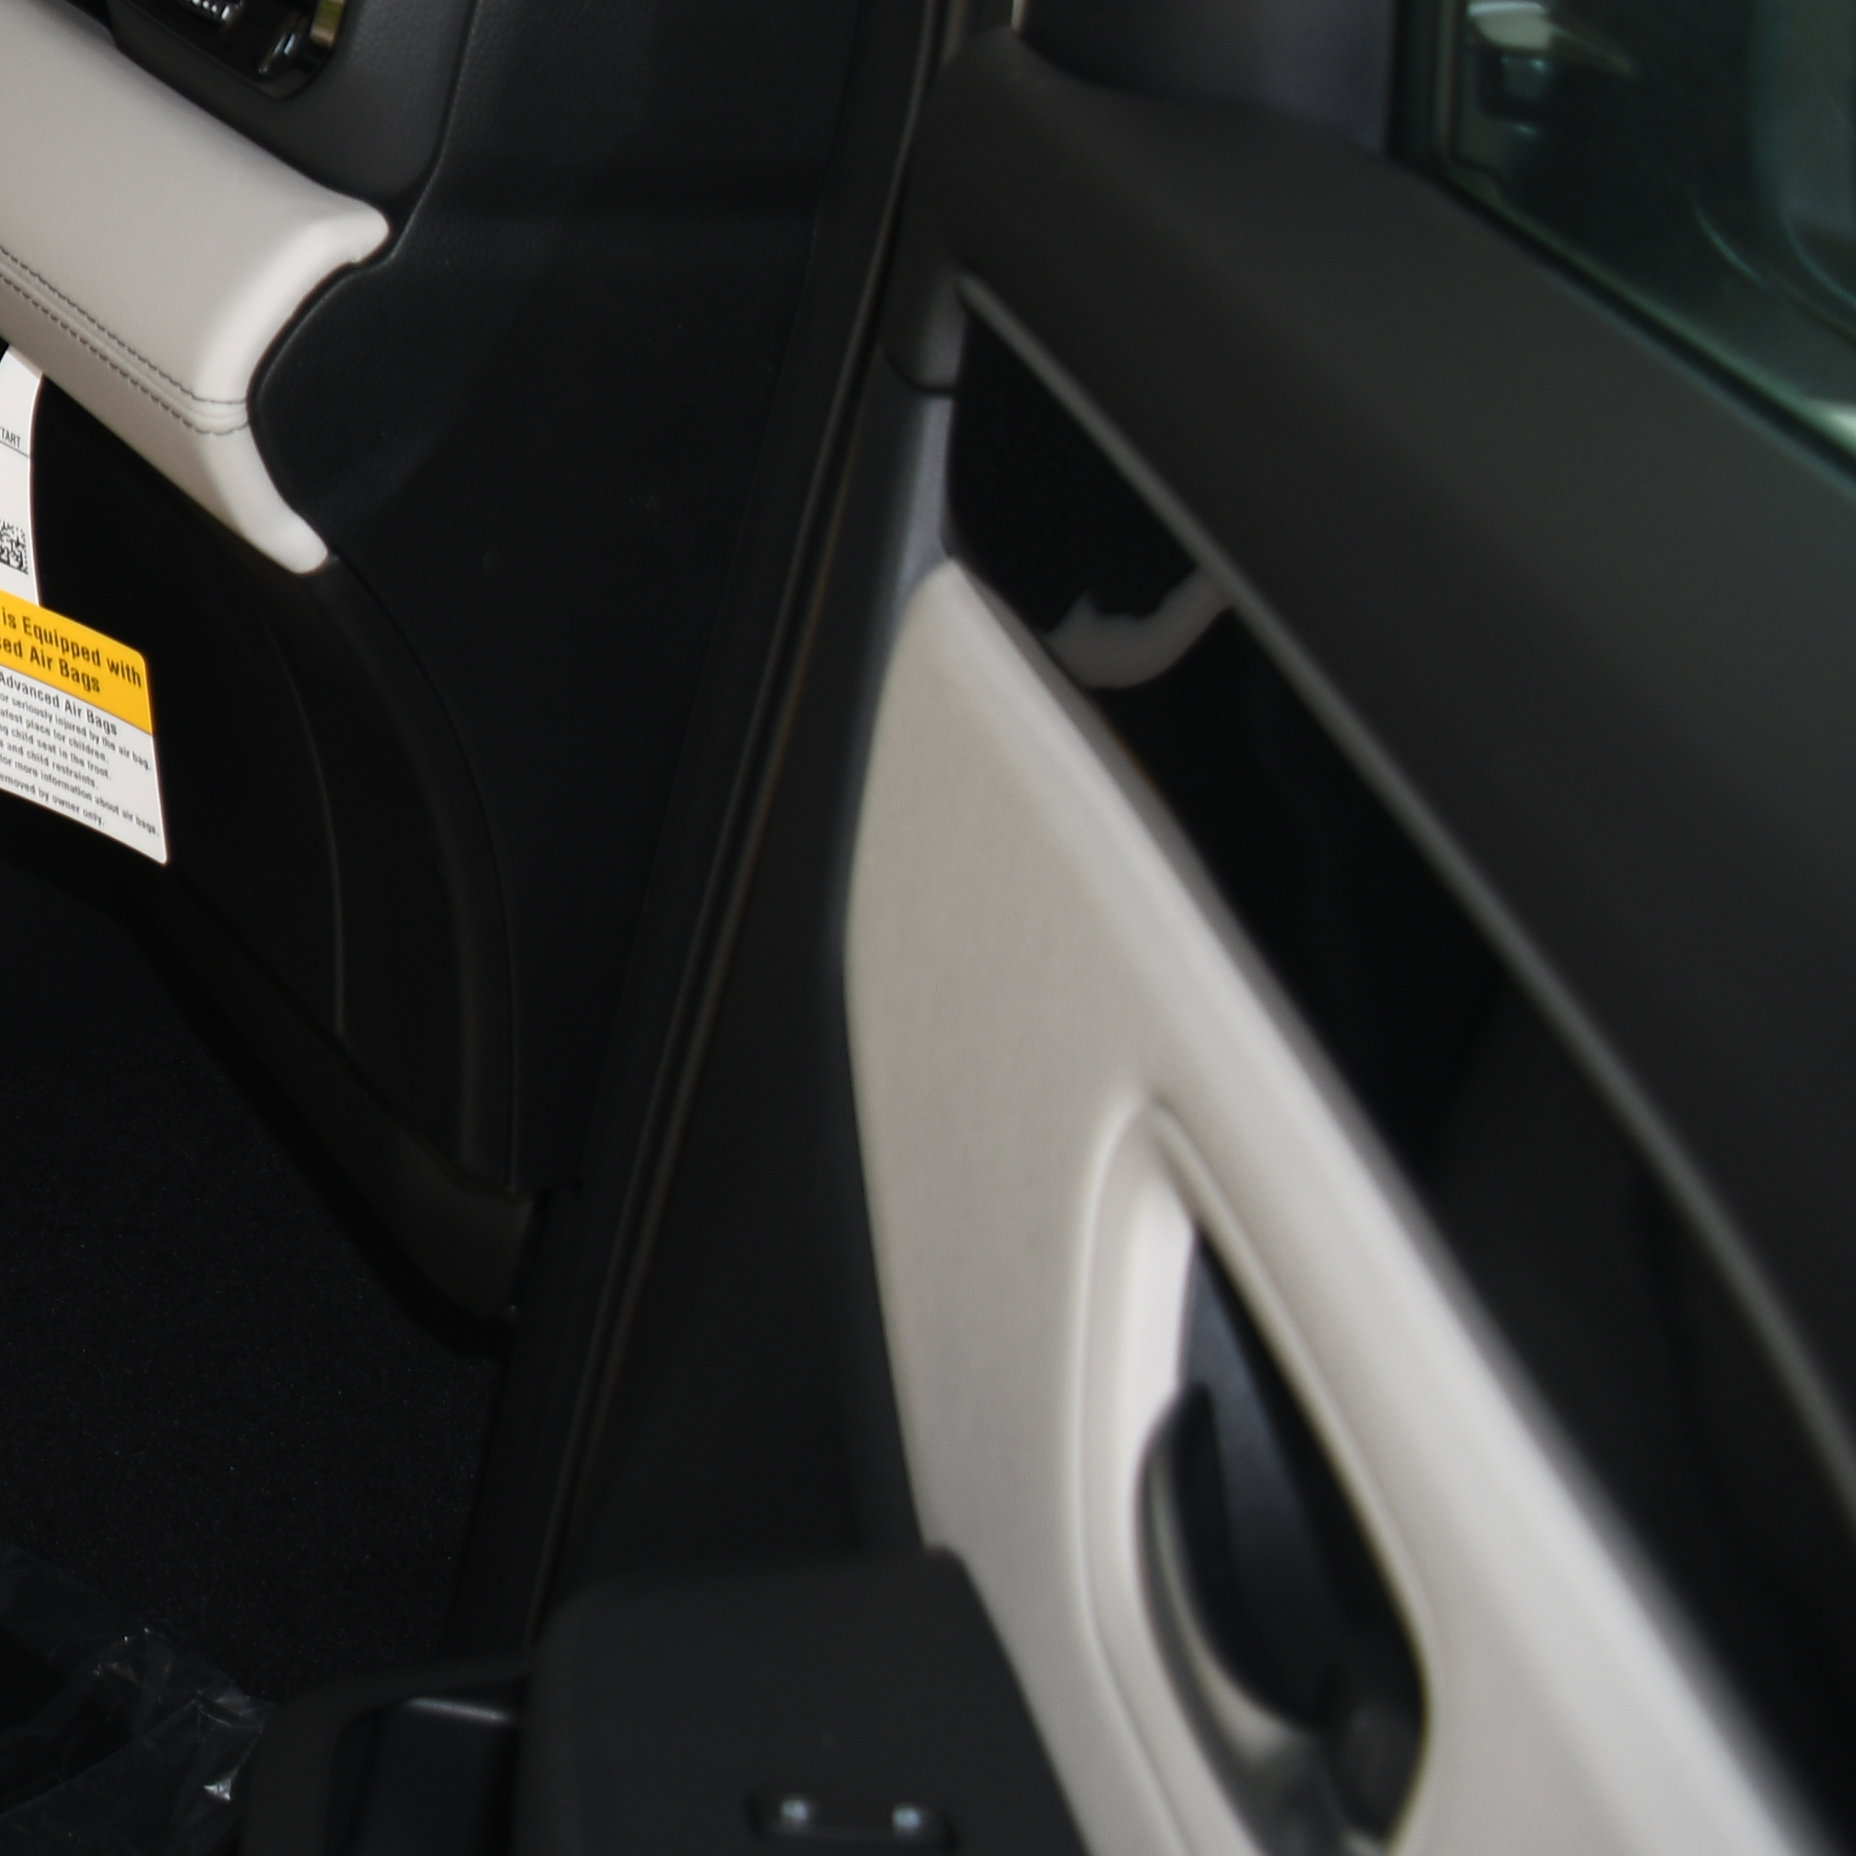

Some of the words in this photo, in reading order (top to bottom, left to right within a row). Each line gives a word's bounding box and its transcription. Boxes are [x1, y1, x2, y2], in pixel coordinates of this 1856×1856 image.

[2, 606, 17, 629] is
[22, 615, 101, 667] Equipped
[106, 657, 142, 688] with
[30, 646, 53, 671] Air
[59, 658, 100, 693] Bags
[0, 693, 9, 703] or
[12, 697, 52, 722] seriously
[55, 714, 87, 737] injured
[89, 729, 100, 745] by
[102, 737, 116, 751] the
[119, 746, 130, 758] air
[25, 719, 51, 737] place
[53, 729, 66, 744] for
[65, 699, 82, 719] Air
[86, 709, 117, 736] Bags
[7, 743, 24, 756] and
[26, 750, 49, 767] child
[11, 728, 34, 745] child
[36, 739, 56, 755] seat
[59, 747, 68, 759] in
[70, 752, 85, 768] the
[0, 753, 12, 766] for
[14, 761, 38, 777] more
[40, 771, 92, 801] information
[95, 796, 119, 815] about
[122, 809, 133, 822] air
[38, 787, 50, 803] by
[52, 795, 80, 814] owner
